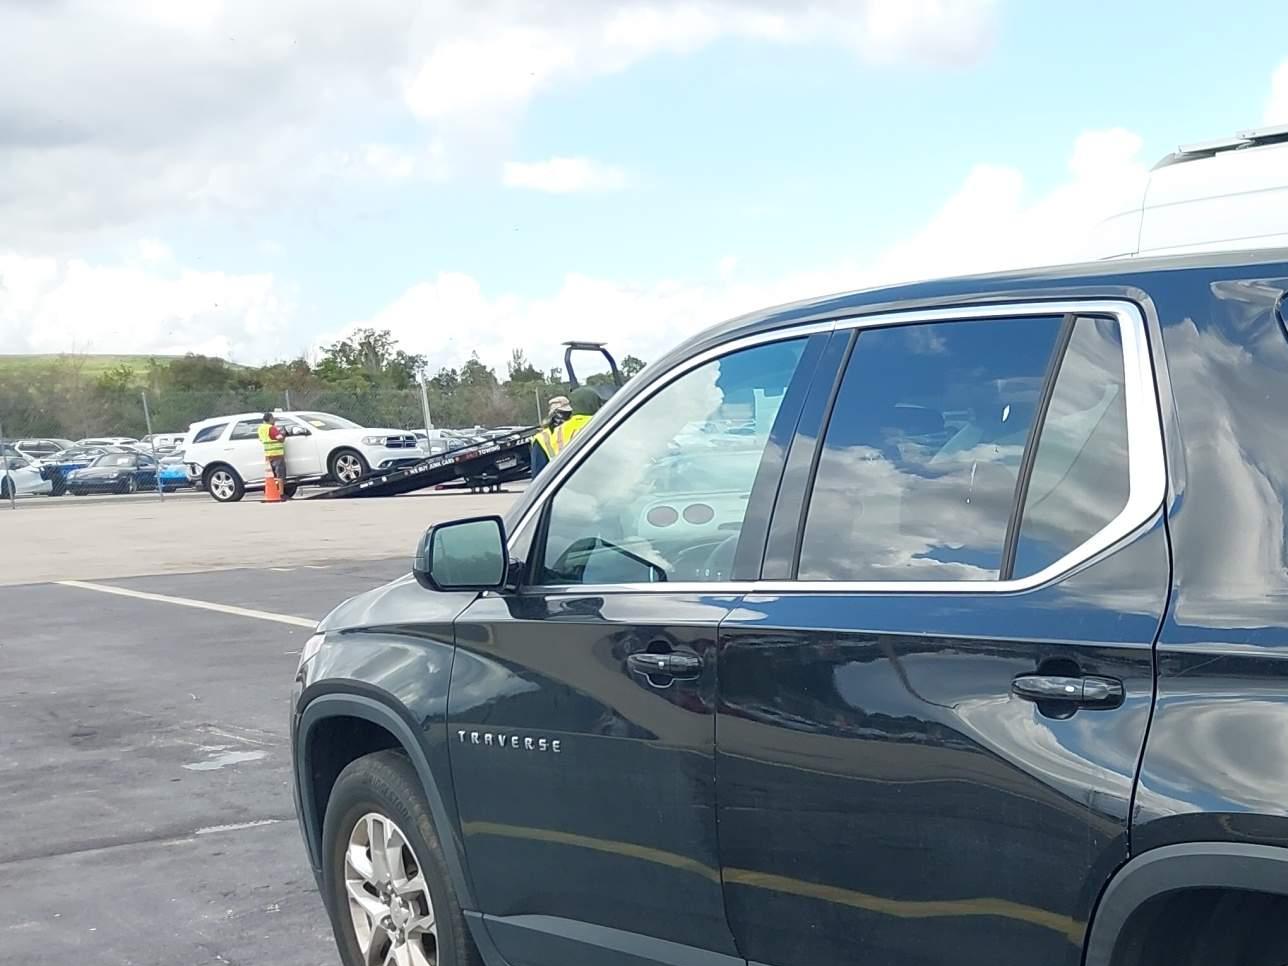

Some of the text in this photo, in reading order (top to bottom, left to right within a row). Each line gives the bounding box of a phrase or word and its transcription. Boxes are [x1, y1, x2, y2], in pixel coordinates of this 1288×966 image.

[478, 444, 500, 456] TOWING
[441, 458, 455, 466] CARS
[457, 730, 561, 752] TRAVERSE
